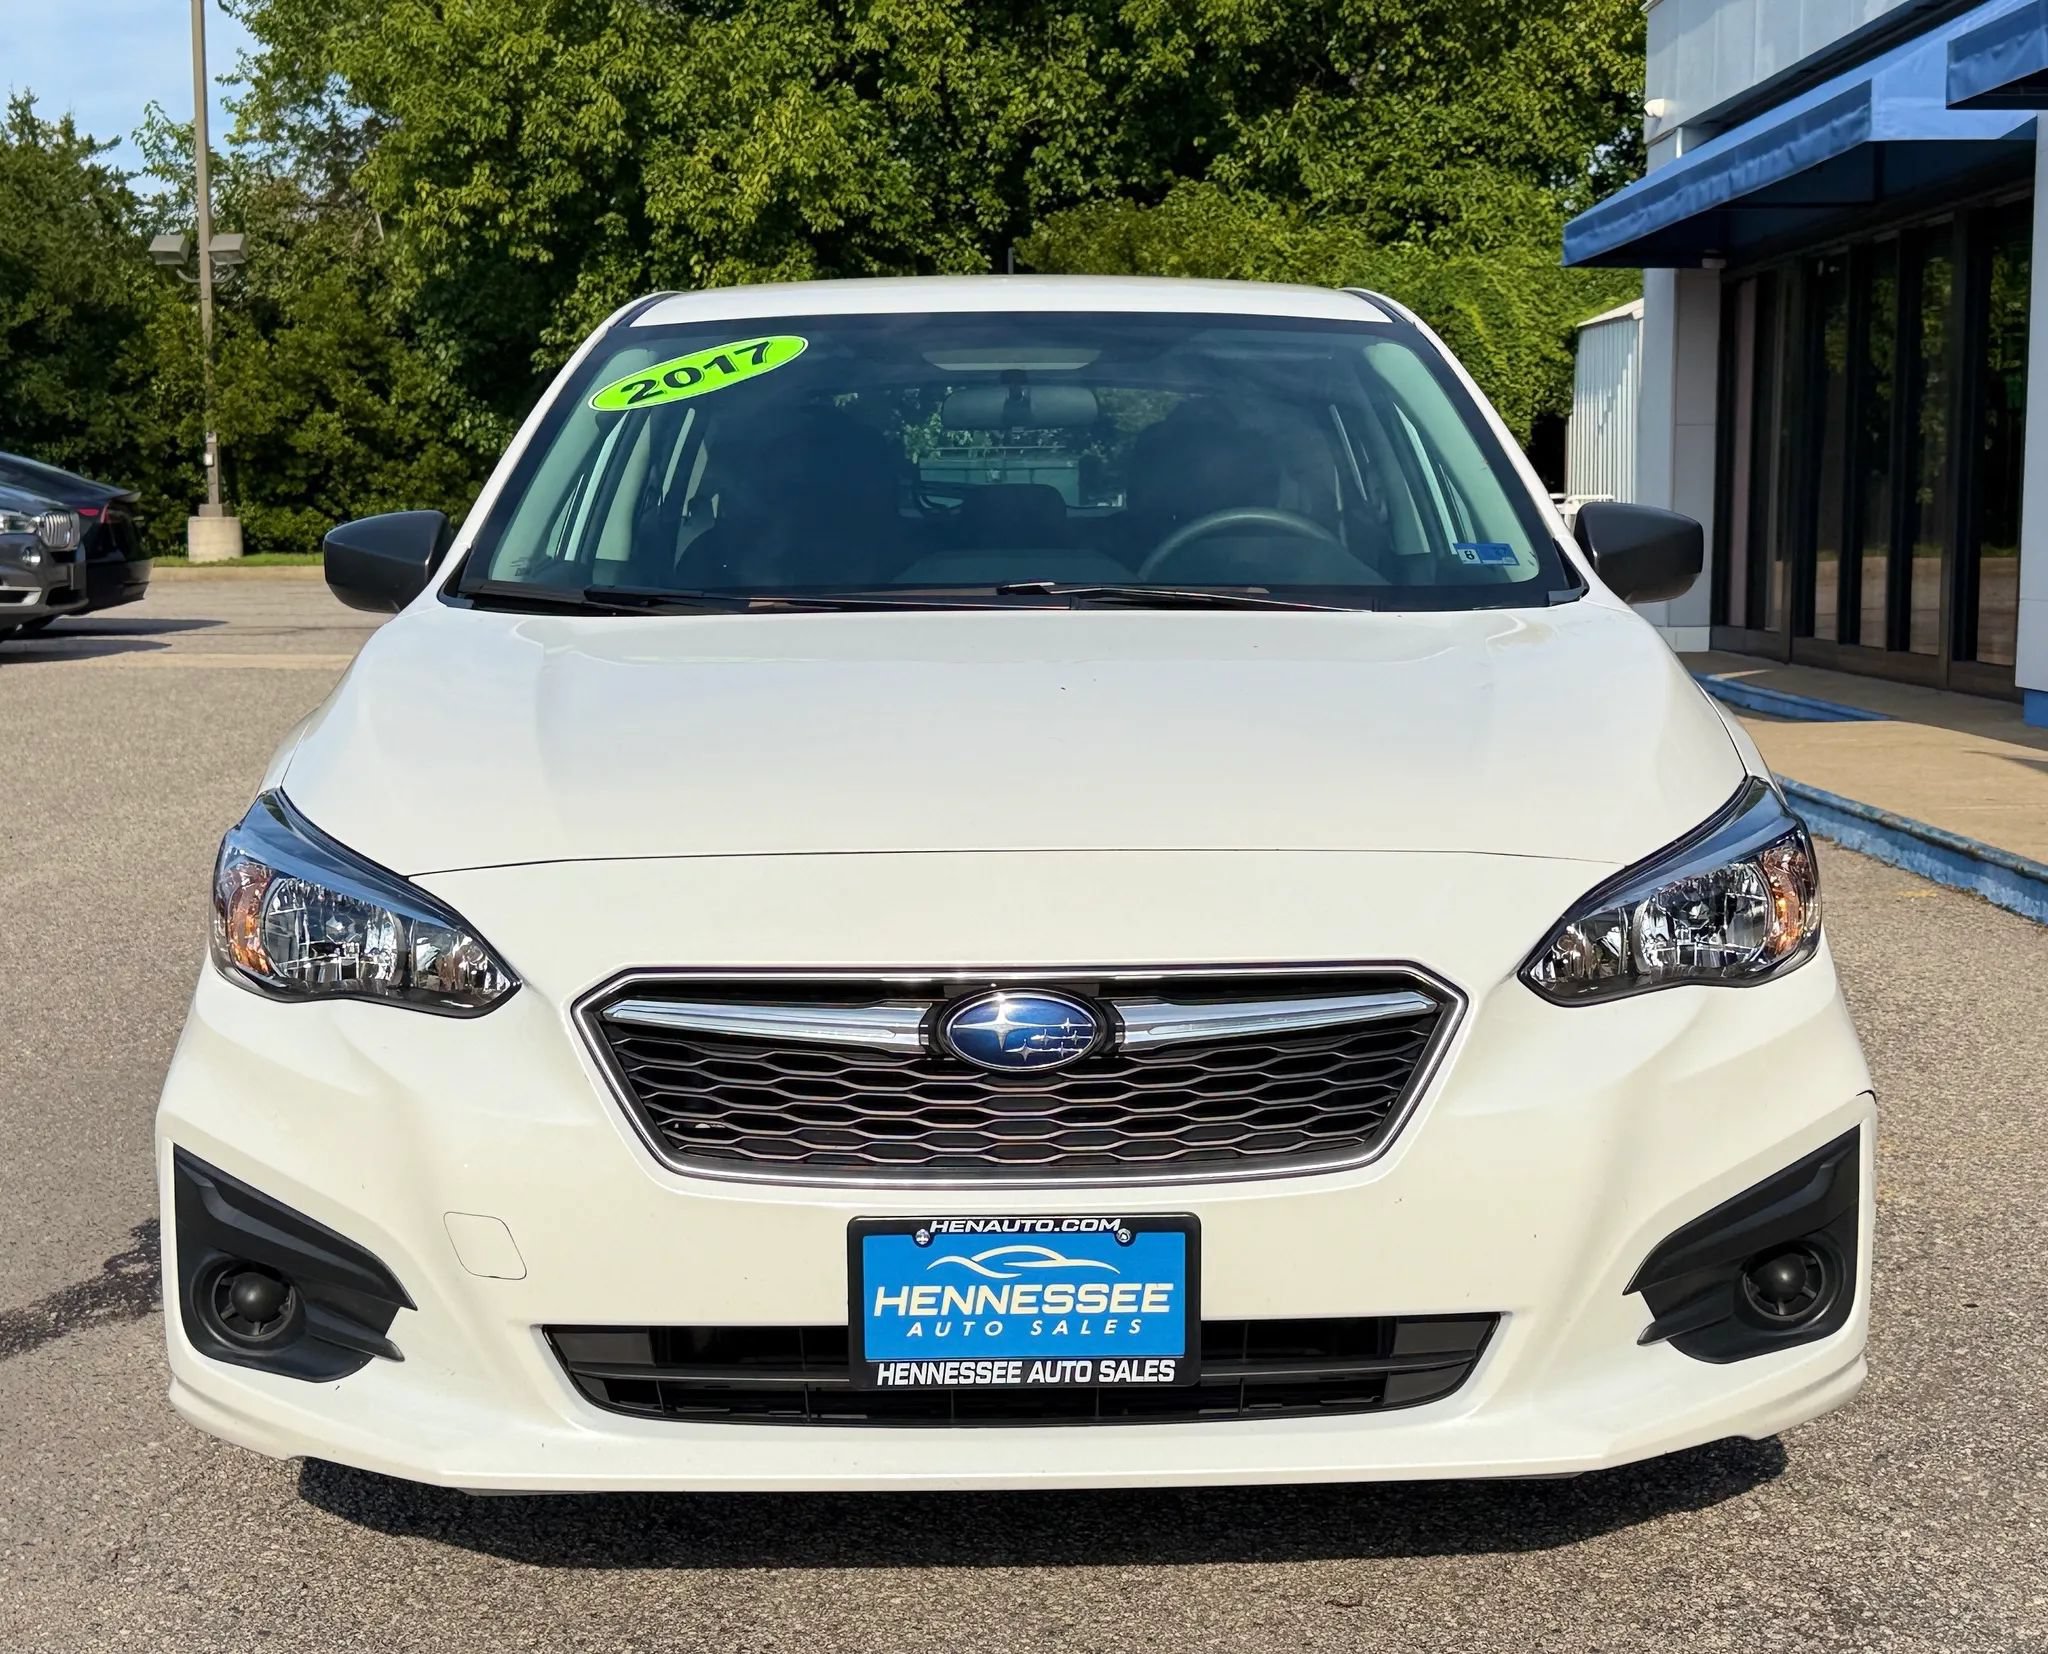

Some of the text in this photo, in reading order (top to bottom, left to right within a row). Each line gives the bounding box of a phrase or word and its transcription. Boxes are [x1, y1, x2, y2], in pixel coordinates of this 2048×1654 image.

[620, 341, 773, 405] 2017
[930, 1218, 1121, 1233] HENAUTO.COM
[873, 1283, 1174, 1317] HENNESSEE
[906, 1319, 1142, 1337] AUTO SALES
[877, 1360, 1175, 1386] HENNESSEE AUTO SALES
